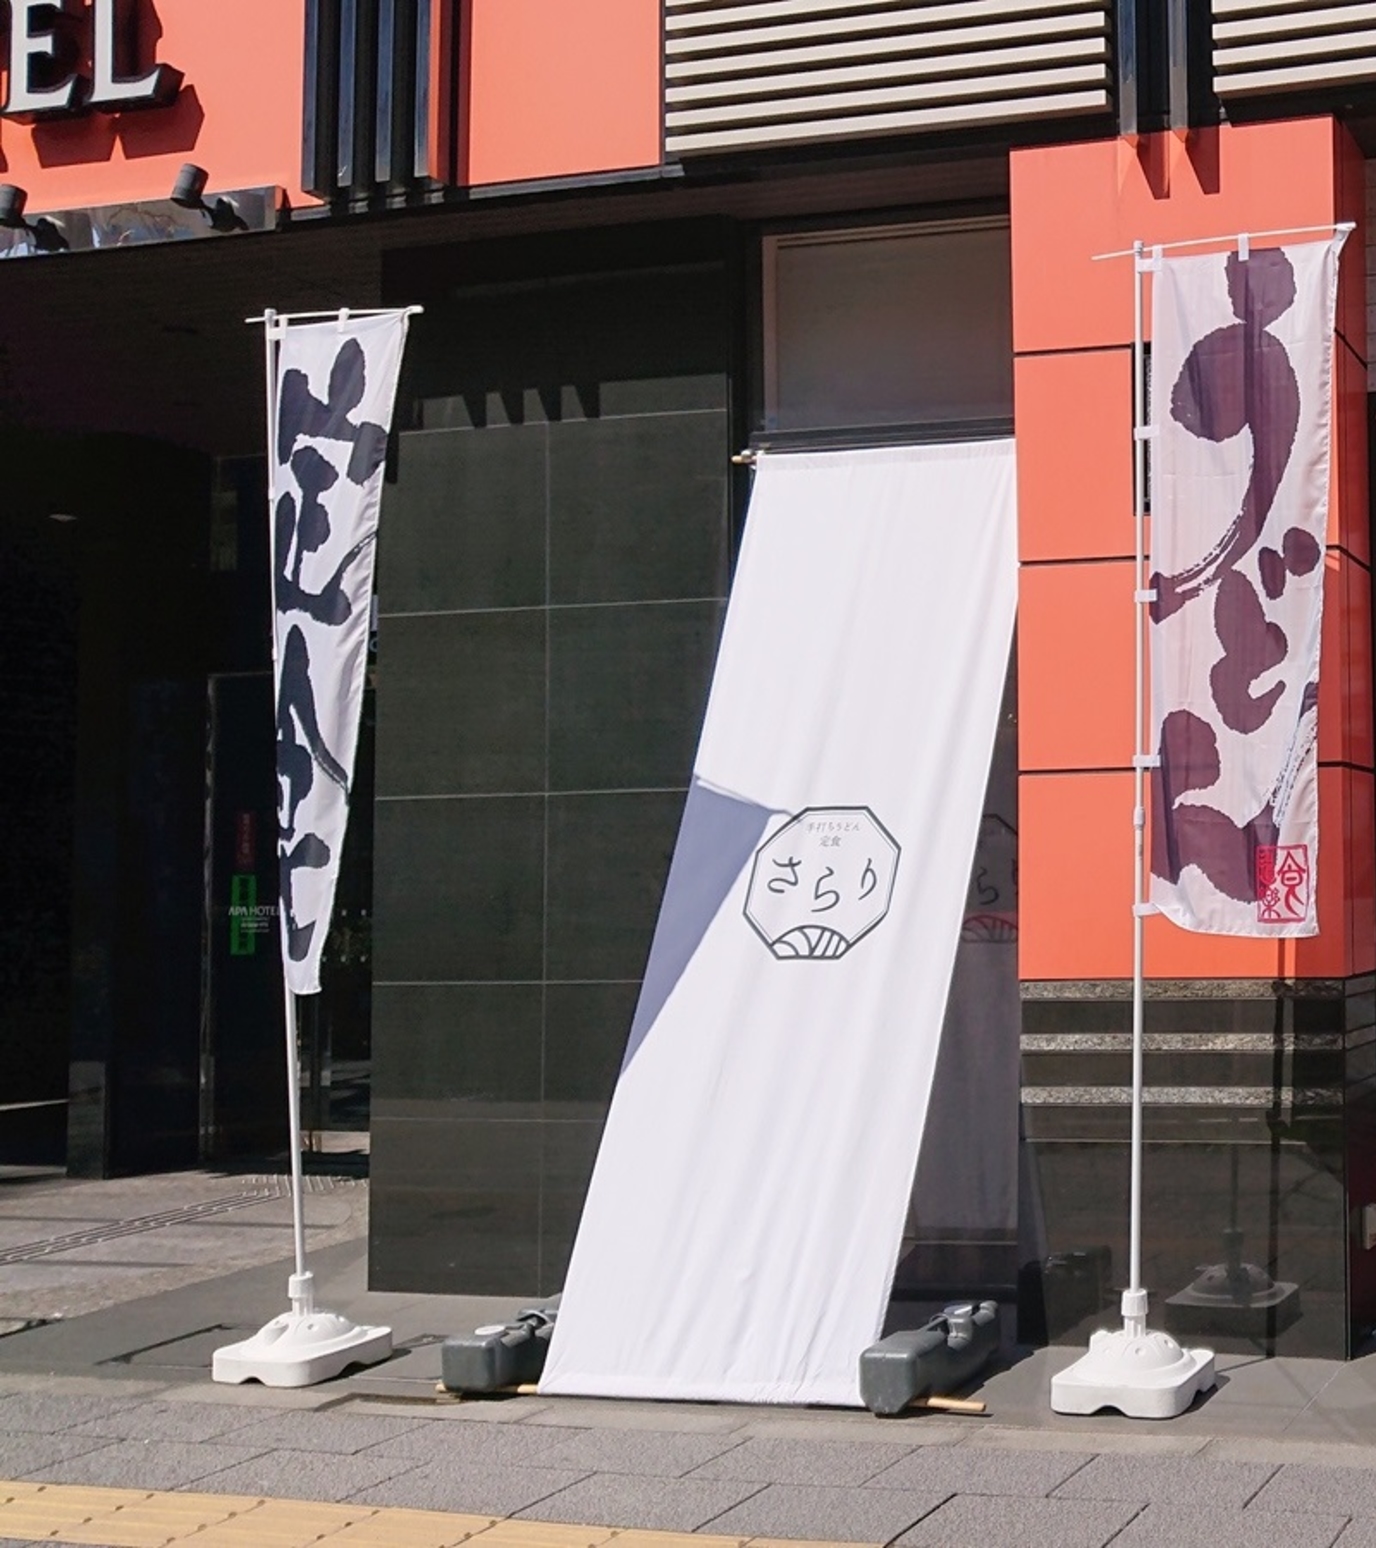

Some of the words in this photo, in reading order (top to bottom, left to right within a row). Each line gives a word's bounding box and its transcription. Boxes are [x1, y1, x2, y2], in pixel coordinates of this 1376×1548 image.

[1149, 246, 1321, 904] うどん
[806, 820, 860, 833] 手打ちうどん
[819, 835, 841, 848] 定食
[766, 856, 878, 913] さらり
